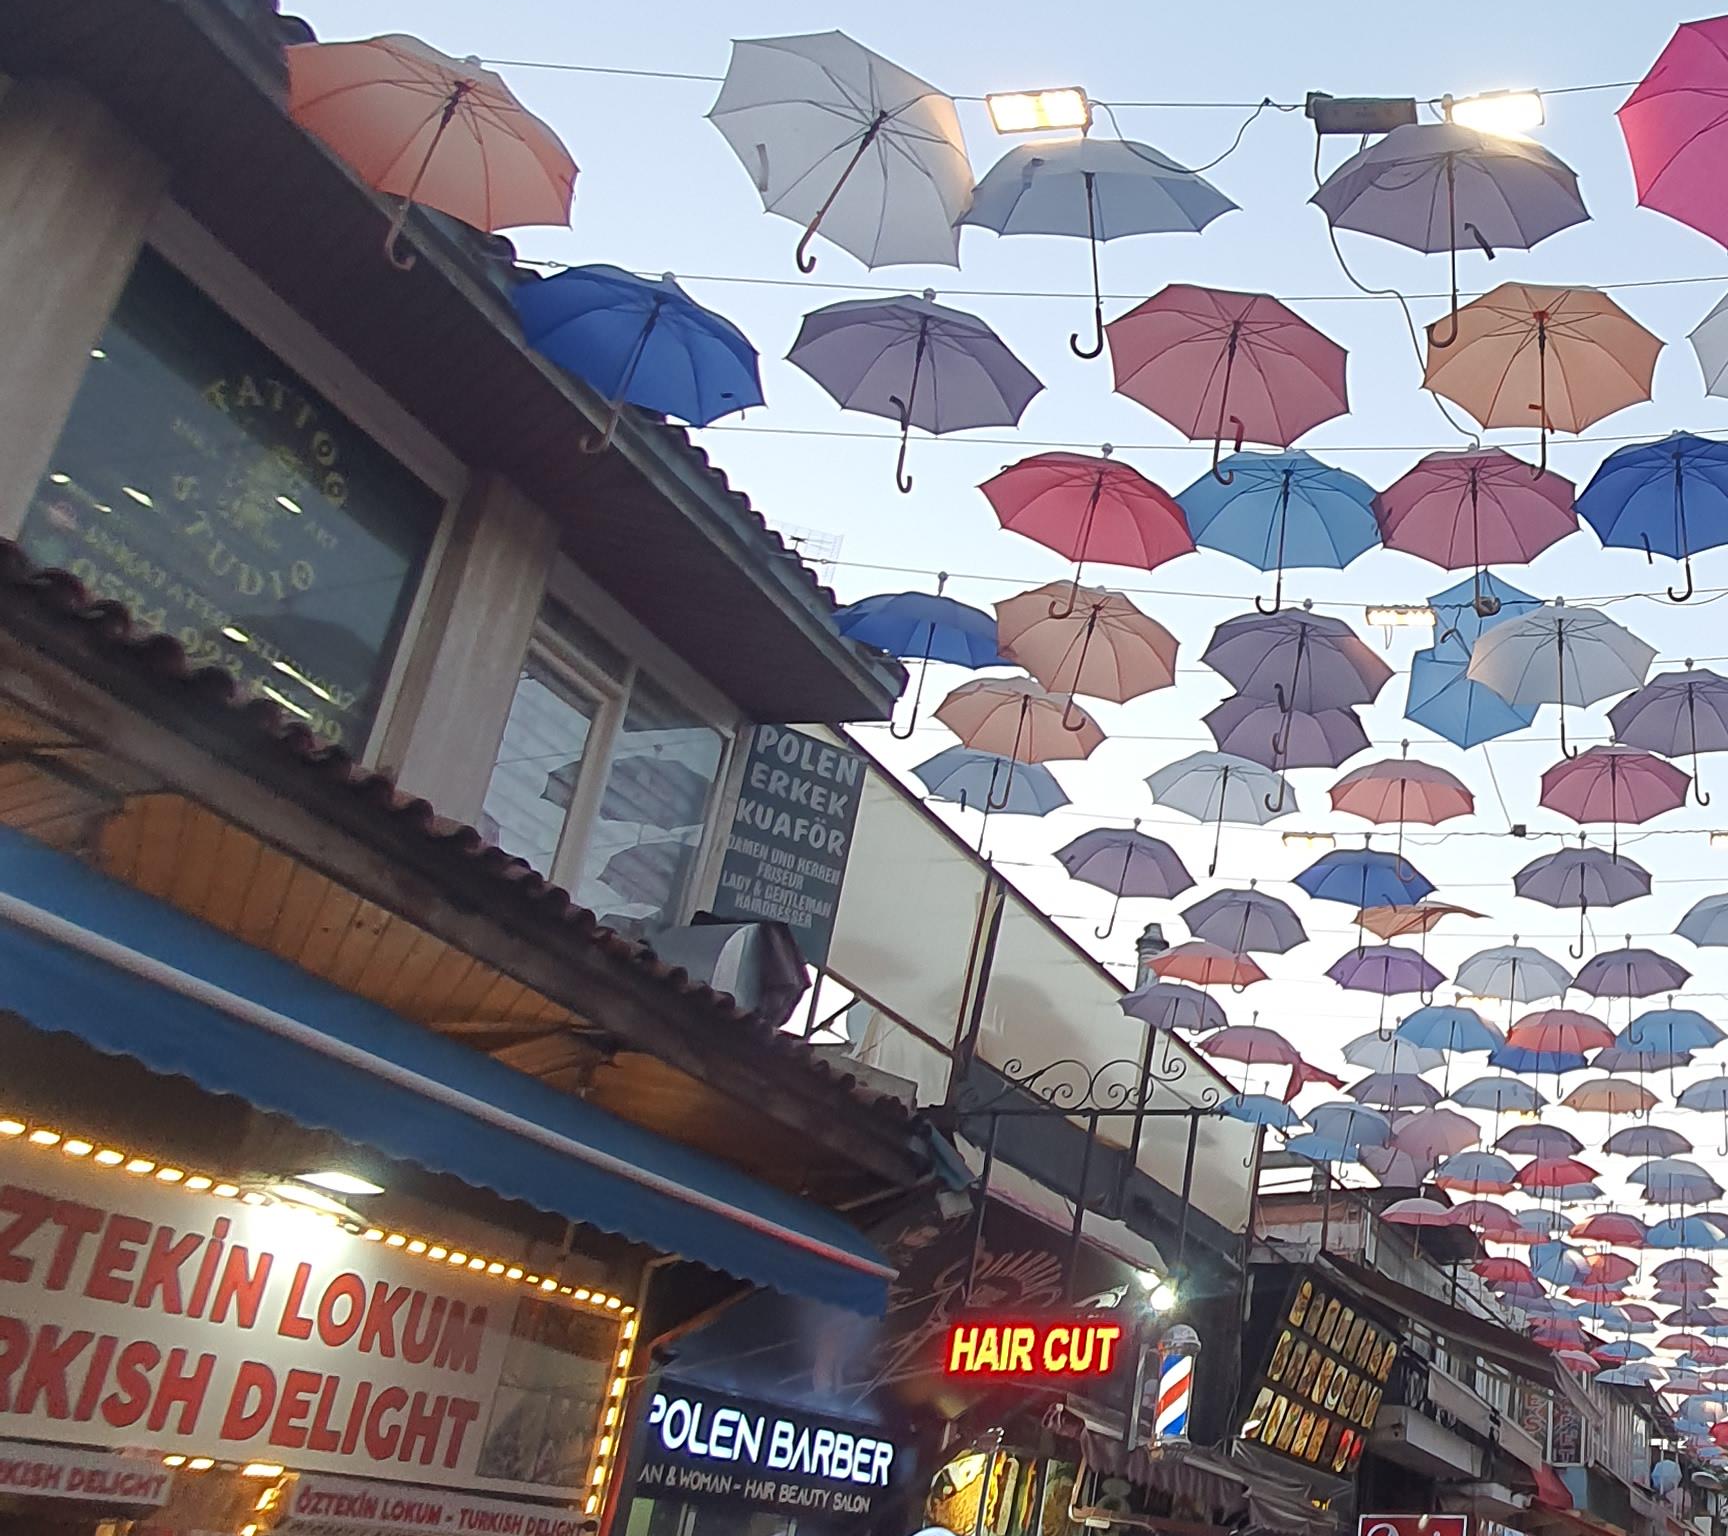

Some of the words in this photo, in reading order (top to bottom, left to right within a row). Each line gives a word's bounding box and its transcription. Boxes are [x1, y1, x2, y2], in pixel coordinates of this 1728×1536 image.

[757, 725, 860, 786] POLEN
[751, 762, 849, 819] ERKEK
[736, 797, 846, 857] KUAFÖR
[728, 834, 769, 861] DAMEN
[771, 848, 795, 870] UND
[799, 855, 841, 886] HERREN
[756, 862, 804, 890] FRISEUR
[722, 870, 750, 891] LADY
[753, 881, 762, 897] &
[764, 884, 833, 919] GENTLEMAN
[278, 1262, 489, 1375] LOKUM
[950, 1327, 1036, 1372] HAIR
[1043, 1327, 1121, 1372] CUT
[220, 1360, 481, 1468] DELIGHT
[649, 1393, 766, 1464] POLEN
[767, 1420, 894, 1487] BARBER
[64, 1466, 168, 1499] DELIGHT
[665, 1466, 677, 1486] &
[679, 1468, 733, 1494] WOMAN
[743, 1479, 776, 1501] HAIR
[778, 1484, 832, 1507] BEAUTY
[833, 1492, 872, 1514] SALON
[379, 1498, 444, 1526] LOKUM
[458, 1507, 524, 1535] TURKISH
